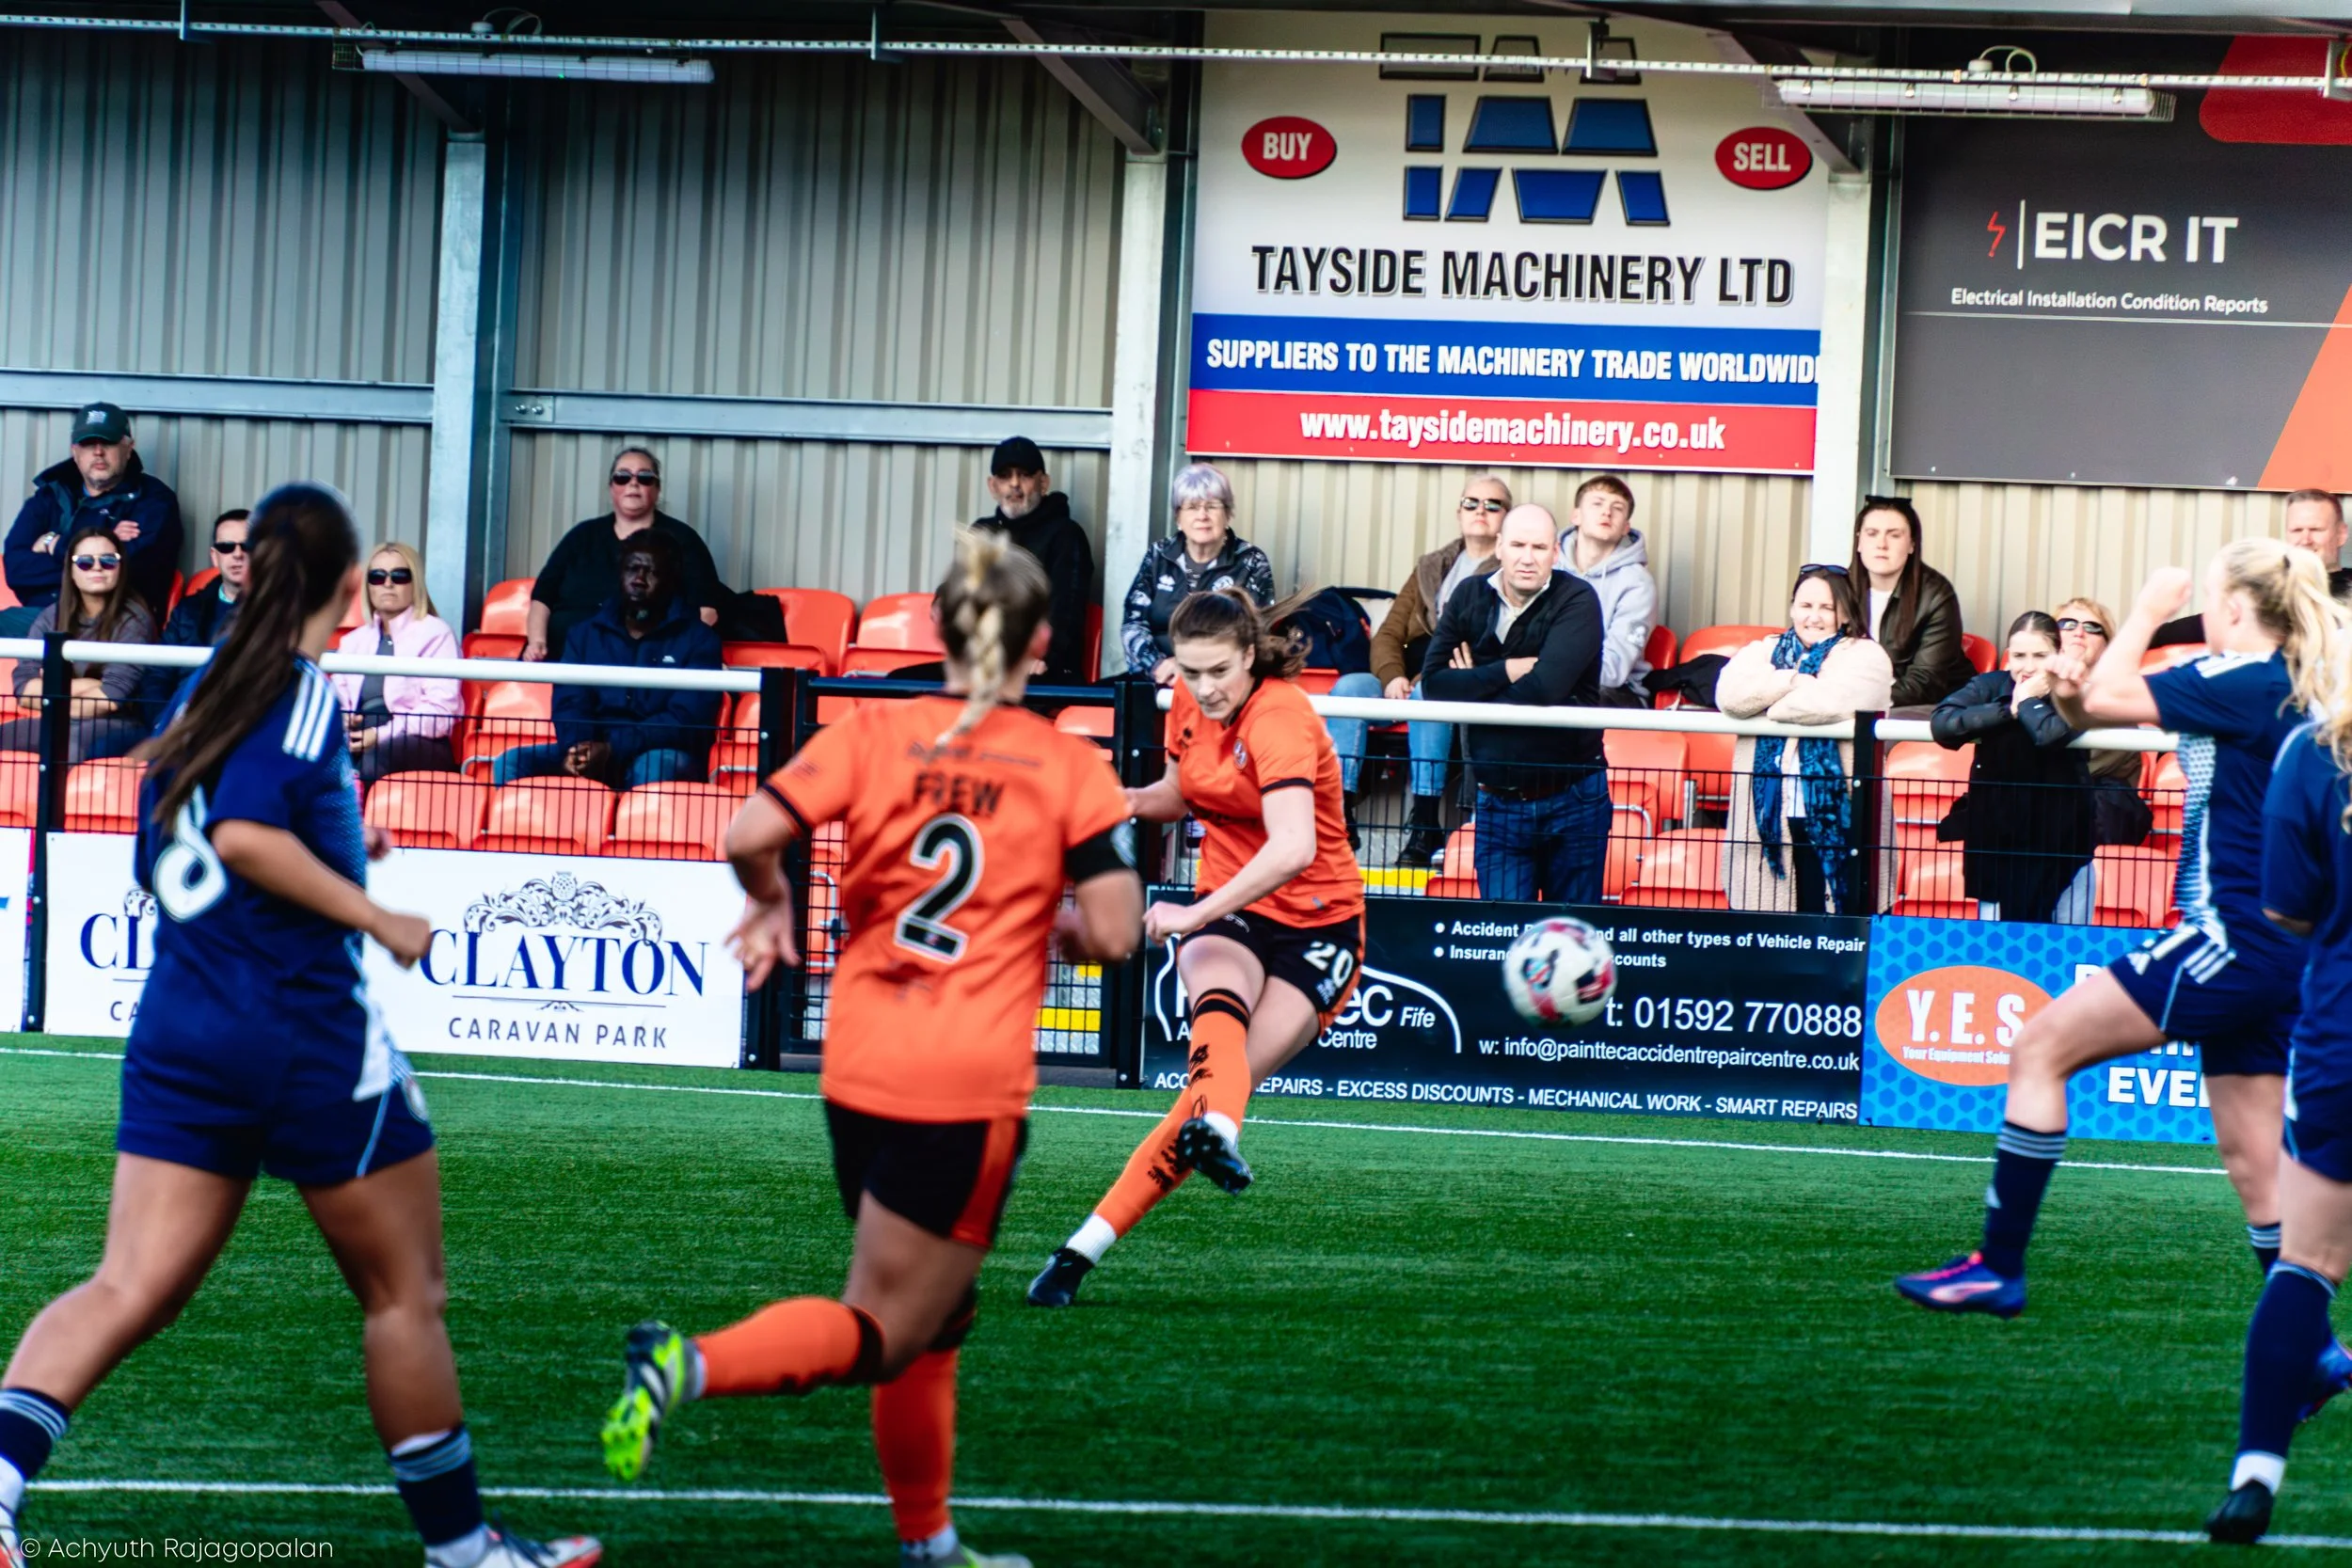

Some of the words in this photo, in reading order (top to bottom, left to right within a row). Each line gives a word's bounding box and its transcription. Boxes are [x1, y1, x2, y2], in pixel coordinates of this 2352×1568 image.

[1262, 133, 1312, 161] BUY
[1733, 143, 1791, 172] SELL
[2034, 212, 2168, 262] EICR
[2185, 215, 2239, 263] IT
[1251, 245, 1426, 297] TAYSIDE
[1441, 251, 1706, 304] MACHINERY
[1718, 258, 1795, 307] LTD
[1951, 288, 2023, 307] Electrical
[2027, 290, 2116, 309] Installation
[2121, 293, 2200, 311] Condition
[2204, 295, 2268, 315] Reports
[1206, 339, 1339, 372] SUPPLIERS
[1345, 343, 1377, 372] TO
[1384, 344, 1430, 373] THE
[1438, 345, 1584, 377] MACHINERY
[1591, 349, 1672, 380] TRADE
[1678, 352, 1820, 384] WORLDWID
[1300, 409, 1726, 454] www.taysidemachinery.co.uk
[893, 812, 985, 964] 2
[1450, 945, 1509, 961] Insuran
[1452, 922, 1518, 938] Accident
[1596, 927, 1613, 942] nd
[1619, 928, 1637, 942] all
[1642, 929, 1683, 944] other
[1688, 931, 1731, 948] types
[1737, 932, 1753, 946] of
[1756, 934, 1812, 950] Vehicle
[1817, 937, 1867, 954] Repair
[420, 928, 709, 997] CLAYTON
[1303, 941, 1354, 988] 20
[448, 1017, 580, 1044] CARAVAN
[596, 1024, 667, 1049] PARK
[1400, 1006, 1436, 1028] Fife
[1634, 997, 1734, 1032] 01592
[1744, 1002, 1862, 1037] 770888
[1318, 1028, 1377, 1050] Centre
[1479, 1039, 1500, 1055] w:
[1504, 1037, 1860, 1071] info@painttecaccidentrepaircentre.co.uk
[1255, 1077, 1323, 1095] EPAIRS
[1337, 1081, 1407, 1100] EXCESS
[1411, 1084, 1514, 1104] DISCOUNTS
[1528, 1088, 1643, 1110] MECHANICAL
[1646, 1094, 1701, 1113] WORK
[1715, 1097, 1775, 1116] SMART
[1782, 1101, 1858, 1119] REPAIRS
